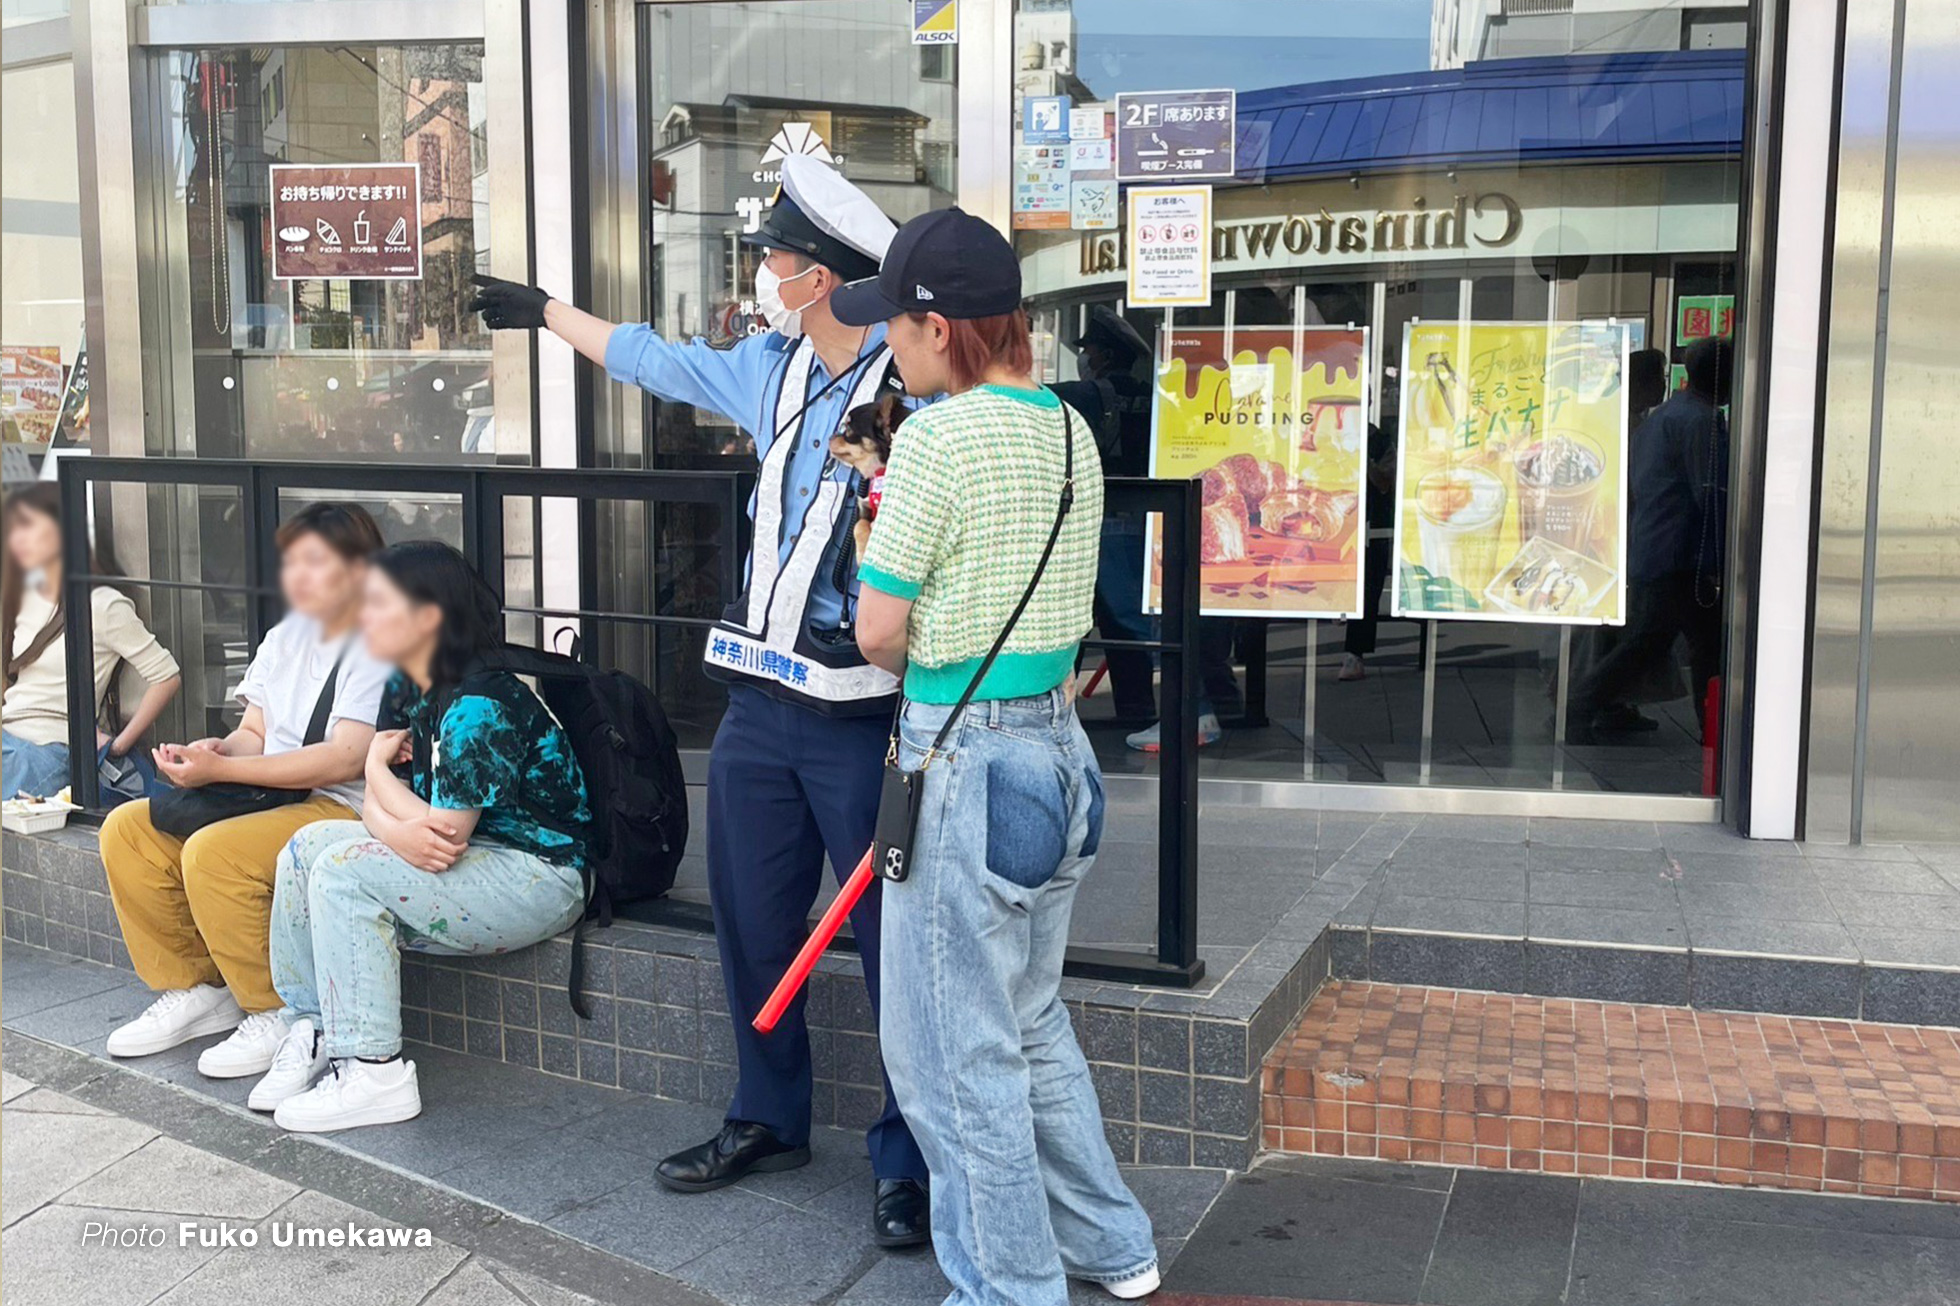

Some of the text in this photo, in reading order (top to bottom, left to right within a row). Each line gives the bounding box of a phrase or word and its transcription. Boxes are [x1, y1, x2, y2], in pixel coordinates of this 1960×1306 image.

[915, 32, 955, 42] ALSOK
[1126, 103, 1159, 126] 2F
[1164, 105, 1229, 122] 席あります
[1204, 411, 1314, 425] PUDDING
[711, 637, 810, 687] 神奈川県警察
